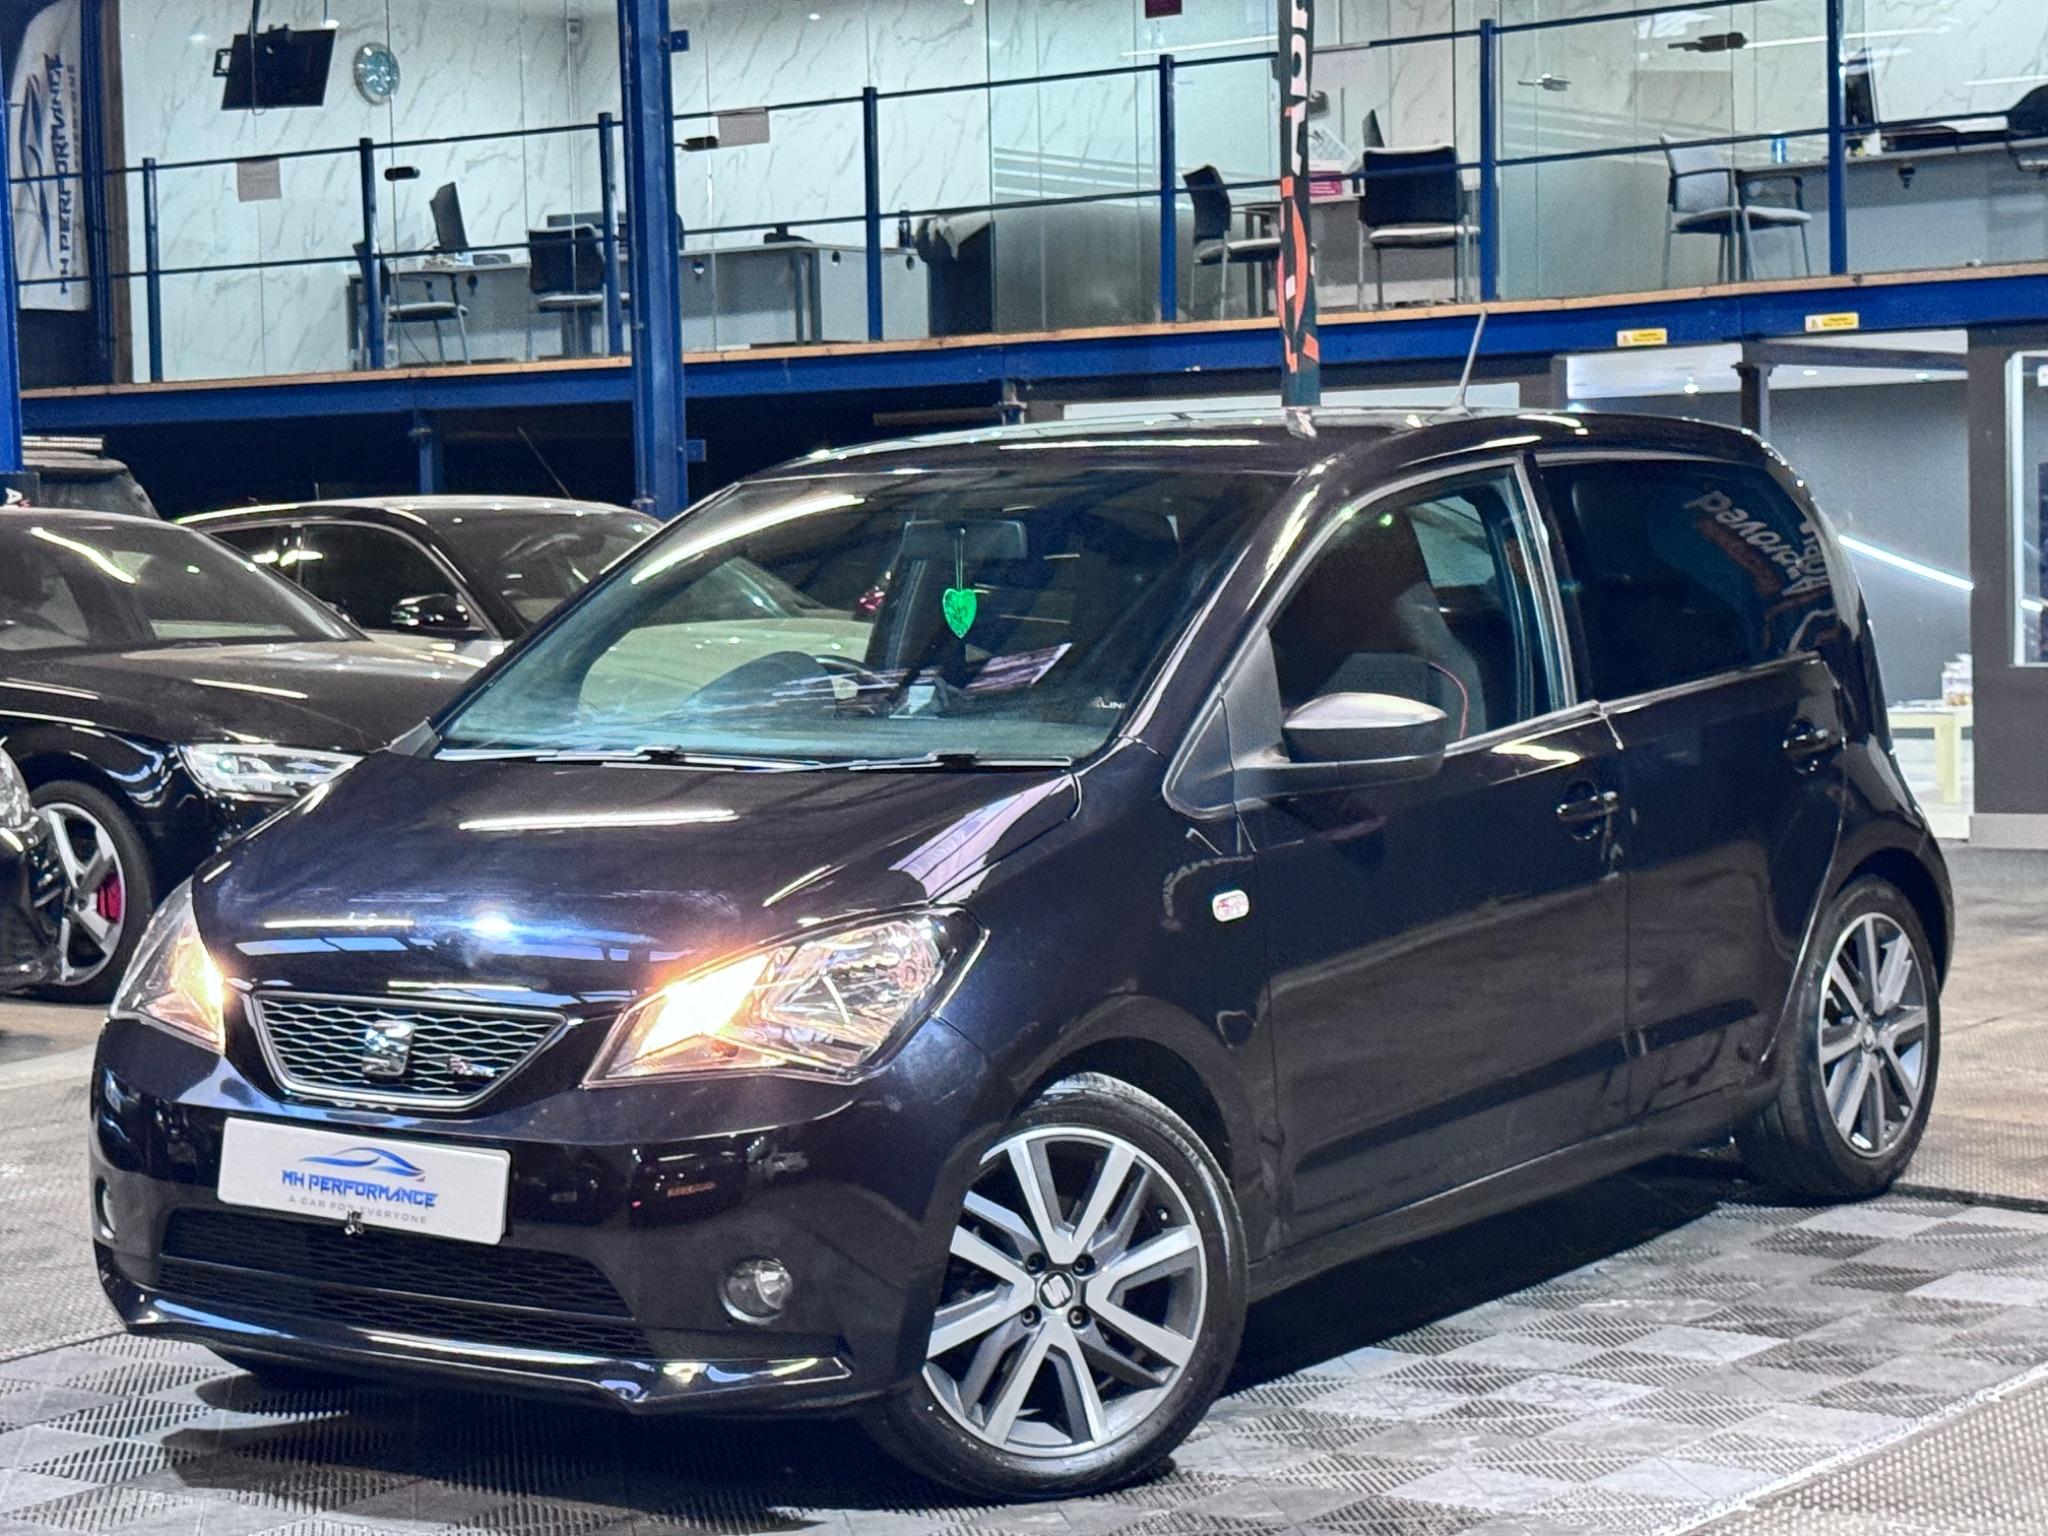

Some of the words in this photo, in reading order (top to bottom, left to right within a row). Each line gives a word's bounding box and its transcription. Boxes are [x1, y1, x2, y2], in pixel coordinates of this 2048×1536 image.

[44, 53, 71, 252] PERFORMANCE
[282, 1170, 305, 1187] MH
[308, 1174, 438, 1209] PERFORMANCE
[288, 1194, 296, 1204] A
[301, 1197, 326, 1209] CAR
